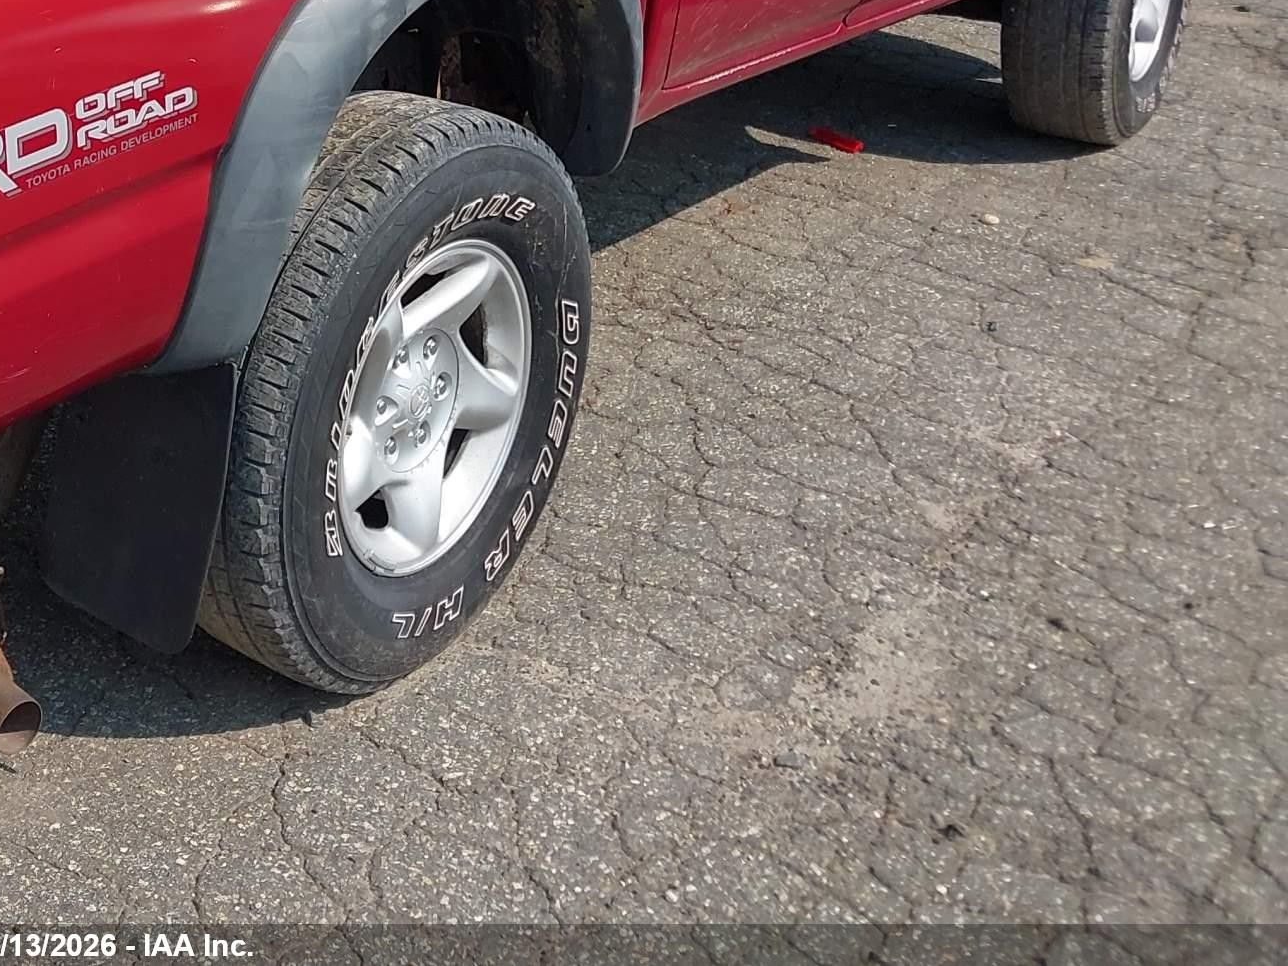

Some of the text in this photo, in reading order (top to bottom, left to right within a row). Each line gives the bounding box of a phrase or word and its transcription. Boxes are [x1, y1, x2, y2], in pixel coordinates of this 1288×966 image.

[75, 70, 165, 122] OFF
[76, 86, 198, 151] ROAD
[25, 113, 199, 189] TOYOTA RACING DEVELOPMENT
[484, 298, 580, 581] DUELER
